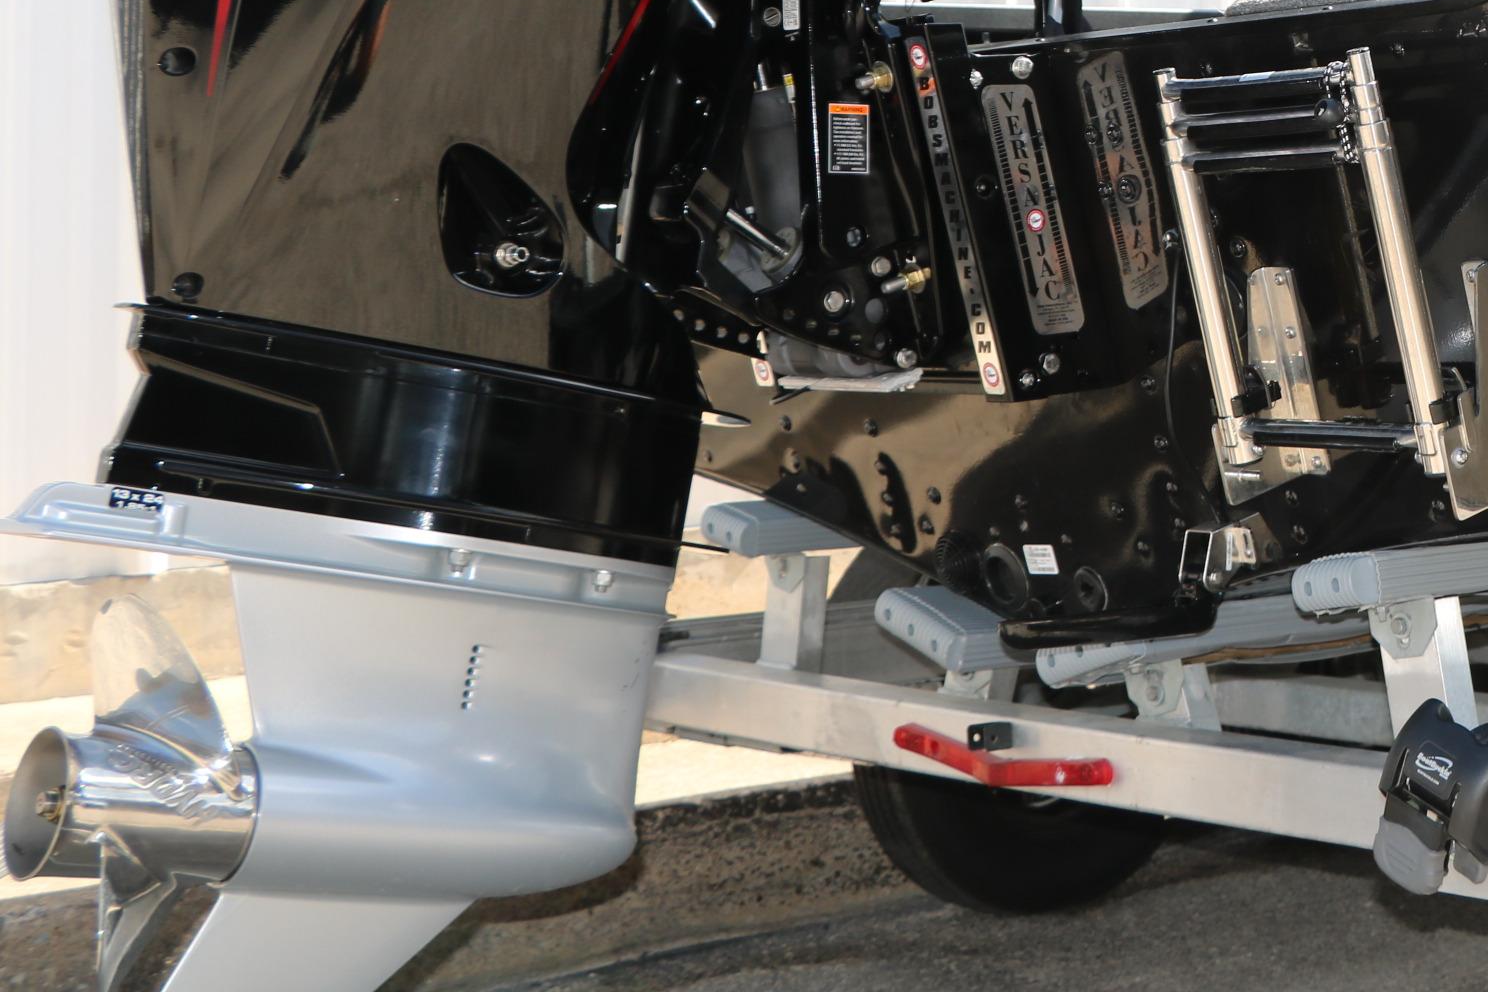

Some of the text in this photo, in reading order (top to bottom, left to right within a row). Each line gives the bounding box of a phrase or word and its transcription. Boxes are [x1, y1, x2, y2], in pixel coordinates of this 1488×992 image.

[919, 76, 992, 354] BOBSMACHINE.COM
[1001, 92, 1039, 206] VERSA
[1037, 234, 1061, 301] JAC
